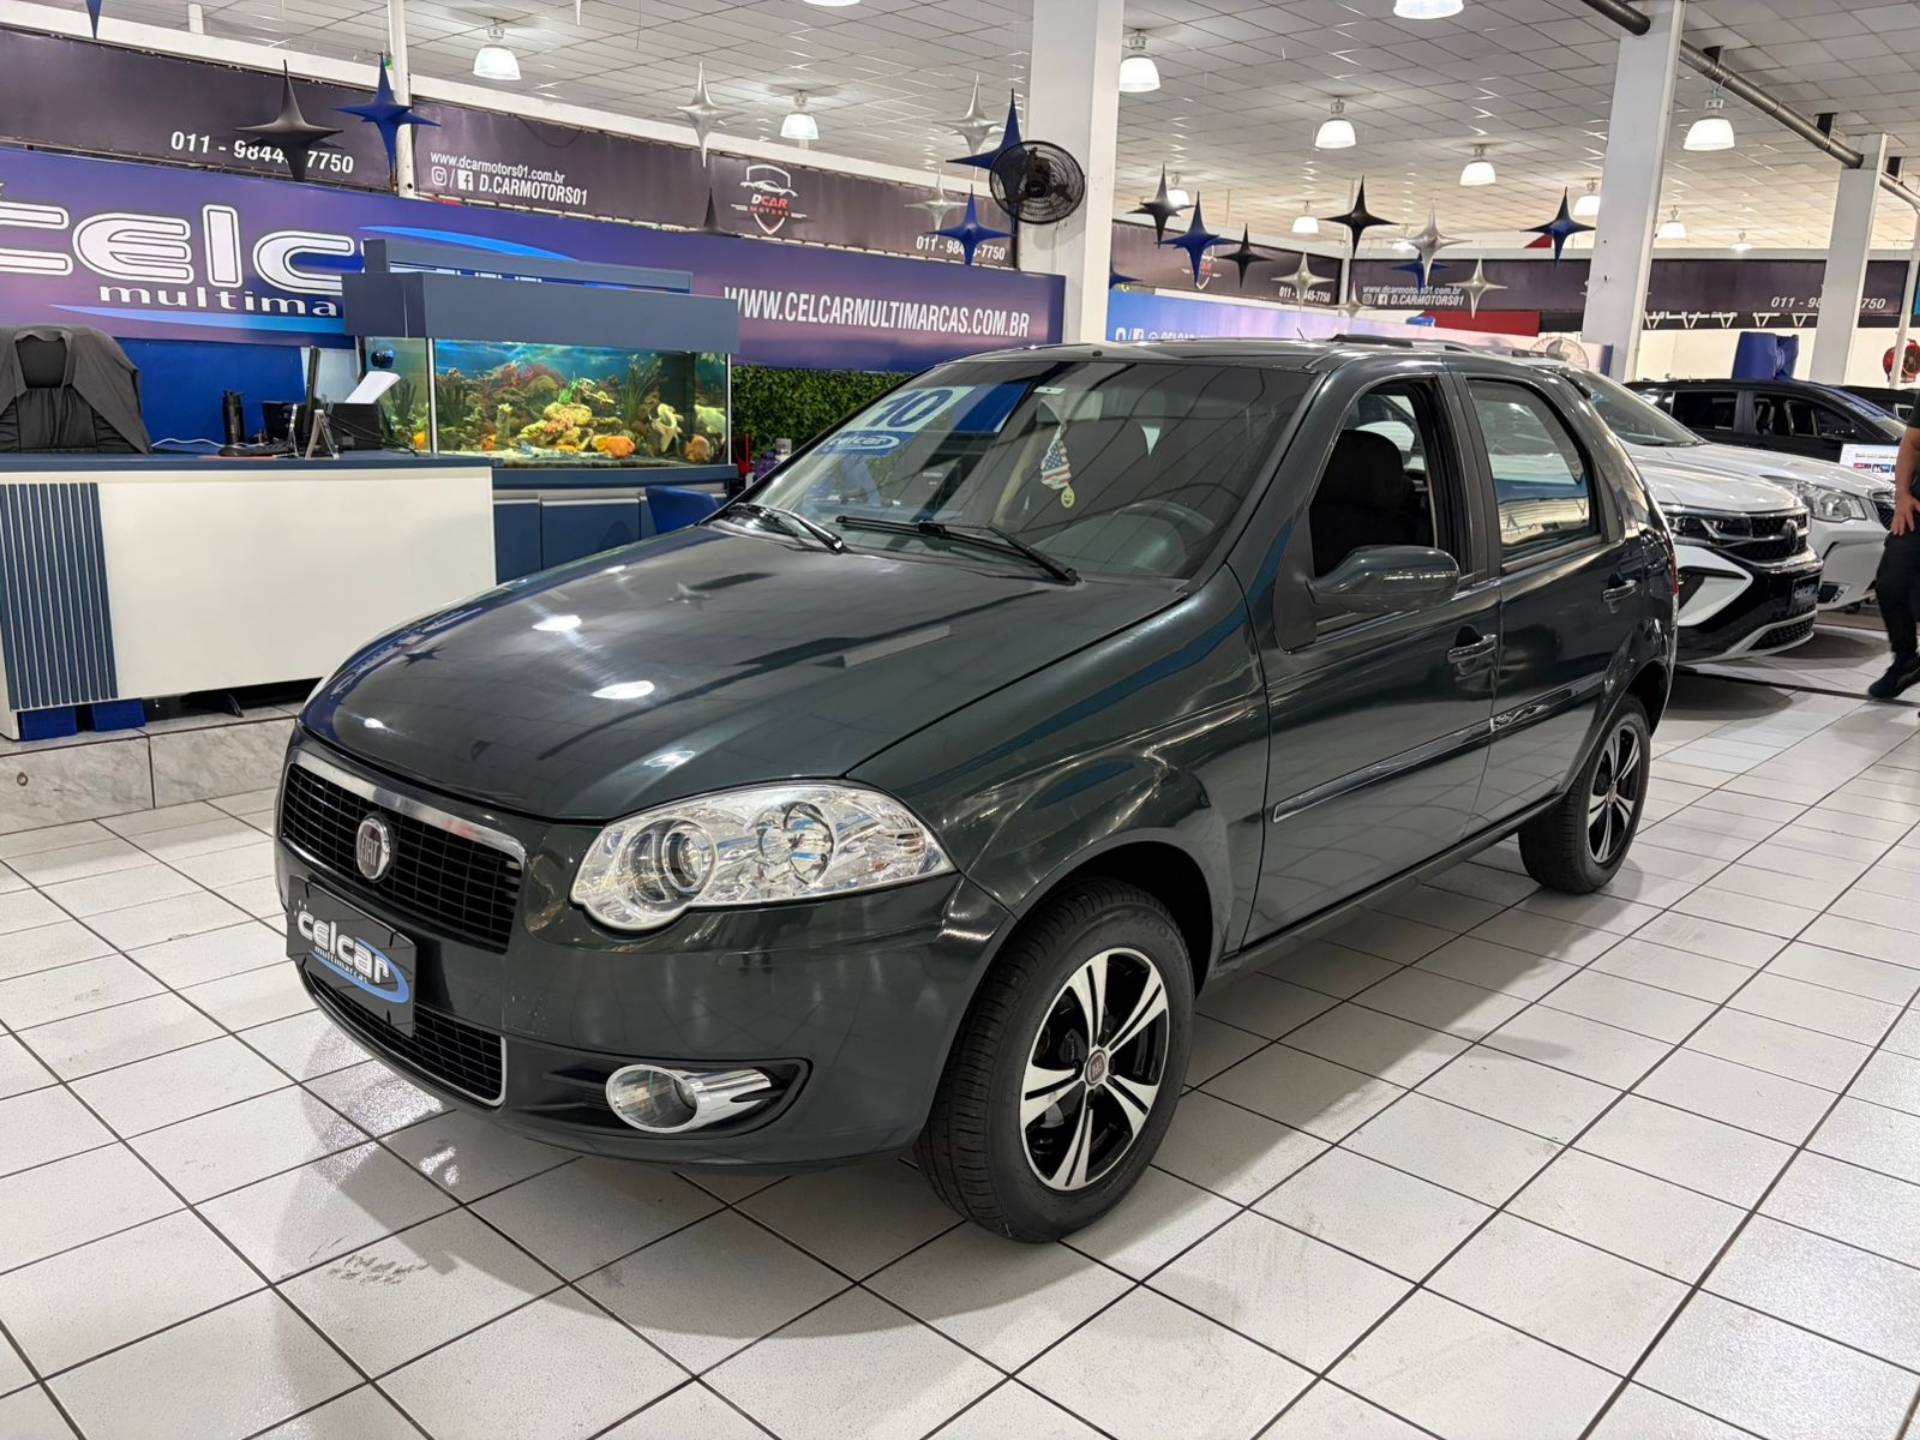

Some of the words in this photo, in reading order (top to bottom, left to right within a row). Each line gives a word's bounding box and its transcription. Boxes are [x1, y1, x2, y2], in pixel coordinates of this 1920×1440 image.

[171, 131, 210, 154] 011
[430, 151, 566, 184] www.dcarmotors01.com.br
[479, 173, 588, 206] D.CARMOTORS01
[751, 193, 788, 209] DCAR
[916, 235, 938, 252] 011
[1771, 297, 1796, 308] 011
[865, 388, 954, 430] 10
[297, 910, 390, 984] celcar
